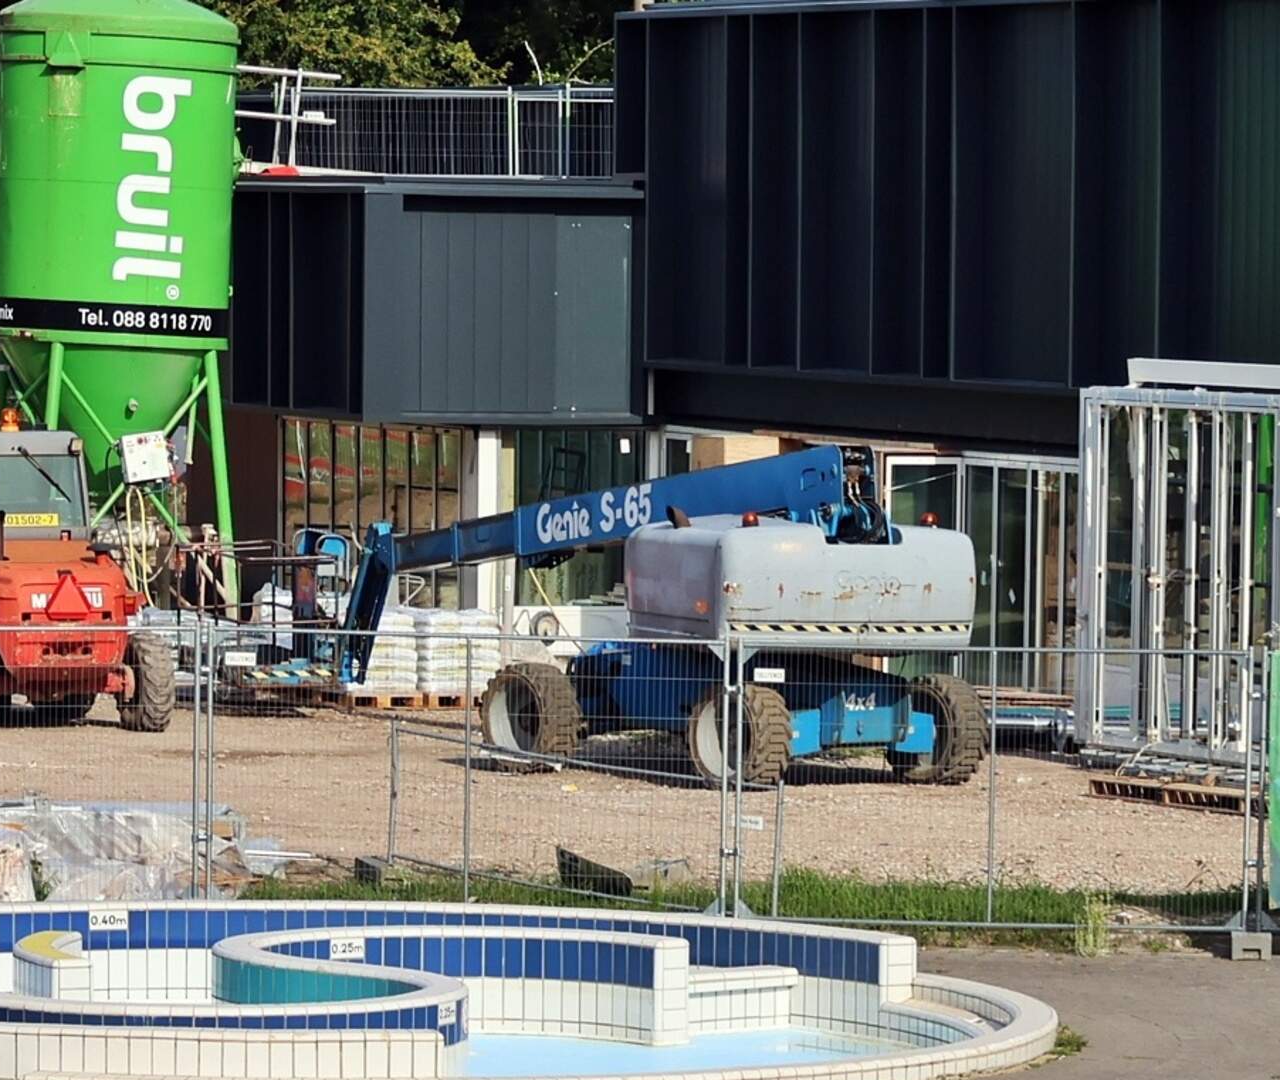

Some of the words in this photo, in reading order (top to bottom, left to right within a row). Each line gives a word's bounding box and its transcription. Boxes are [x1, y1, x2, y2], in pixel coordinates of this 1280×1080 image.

[112, 75, 192, 281] bruil
[78, 308, 109, 326] Tel.
[112, 310, 145, 328] 088
[149, 312, 187, 330] 8118
[190, 315, 212, 332] 770
[537, 501, 590, 544] Genie
[600, 483, 651, 532] S-65
[846, 692, 876, 711] 4x4
[90, 914, 127, 926] 0.40m
[331, 942, 364, 955] 0.25m
